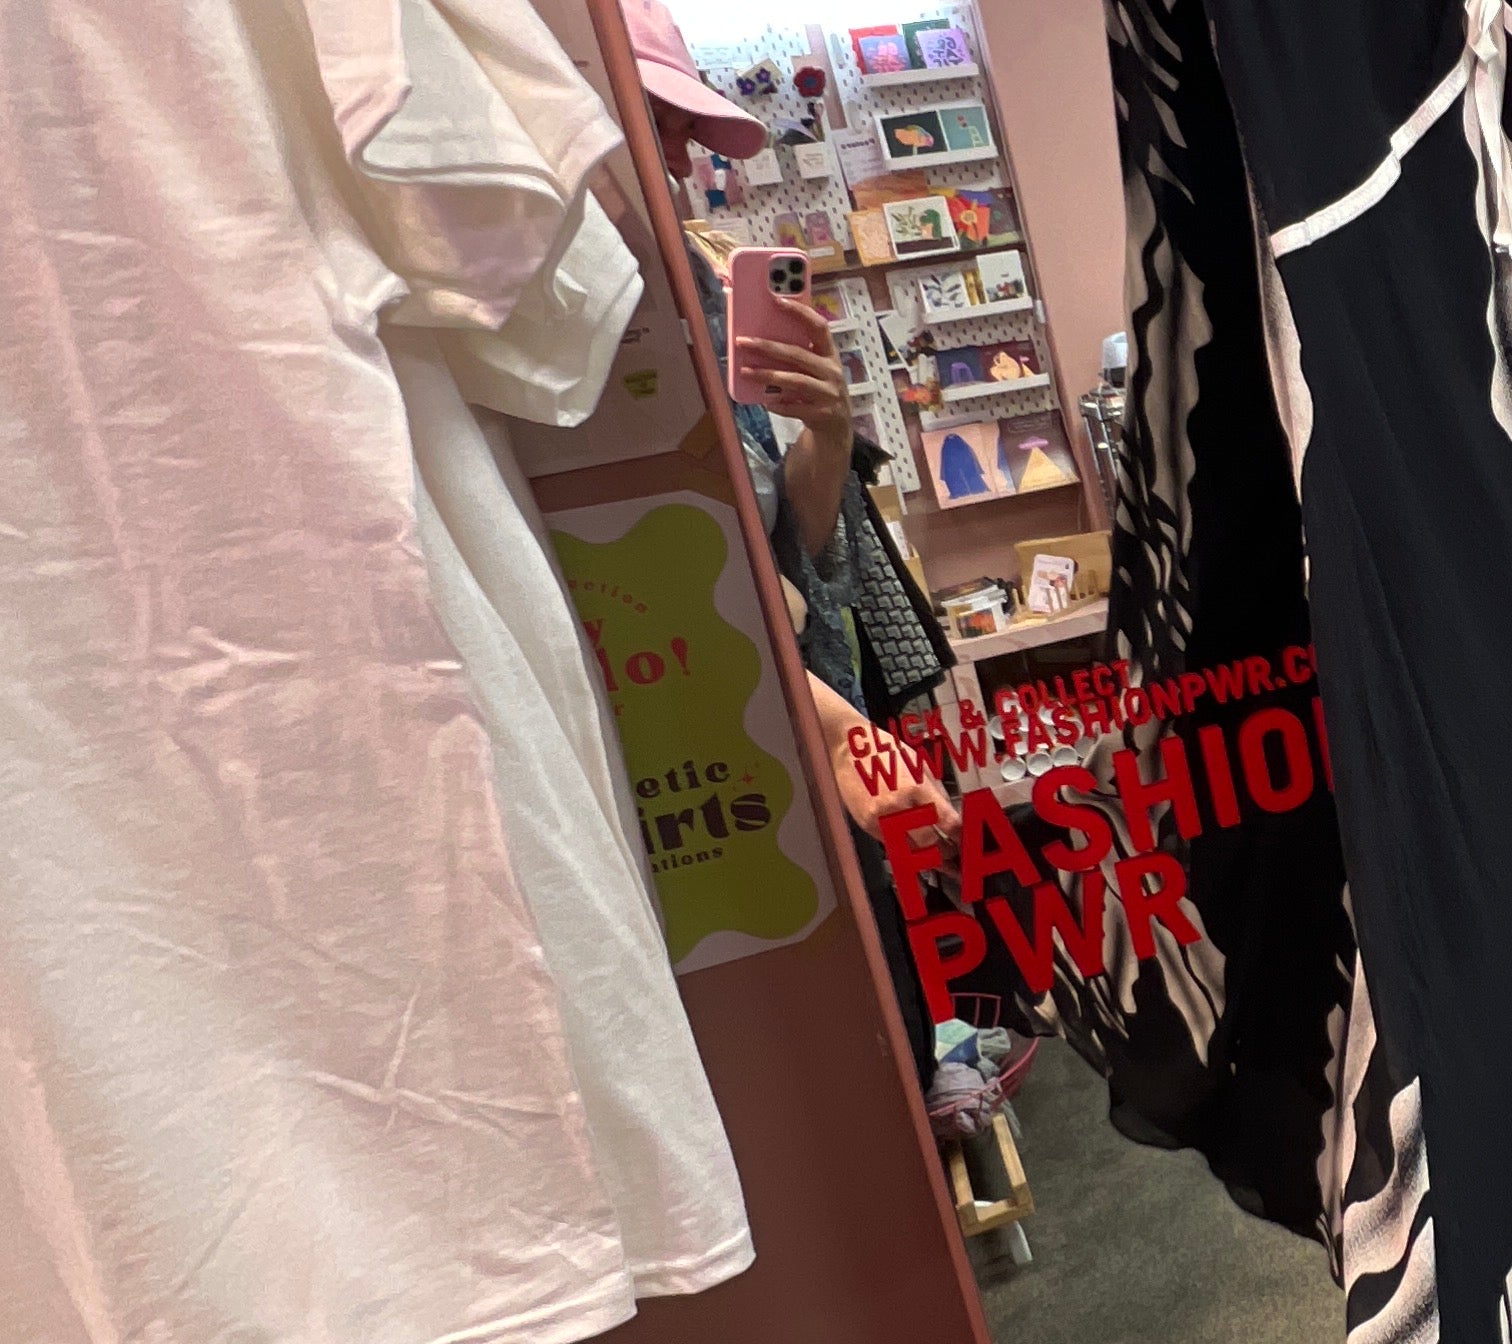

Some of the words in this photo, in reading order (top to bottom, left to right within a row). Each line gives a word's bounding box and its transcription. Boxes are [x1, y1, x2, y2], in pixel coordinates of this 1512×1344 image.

[597, 636, 692, 692] lo!
[847, 697, 943, 760] CLICK
[958, 698, 984, 731] &
[993, 658, 1131, 724] COLLECT
[853, 641, 1317, 798] WWW.FASHIONPWR.C
[636, 759, 730, 799] etic
[637, 793, 771, 856] irts
[906, 850, 1201, 1025] PWR
